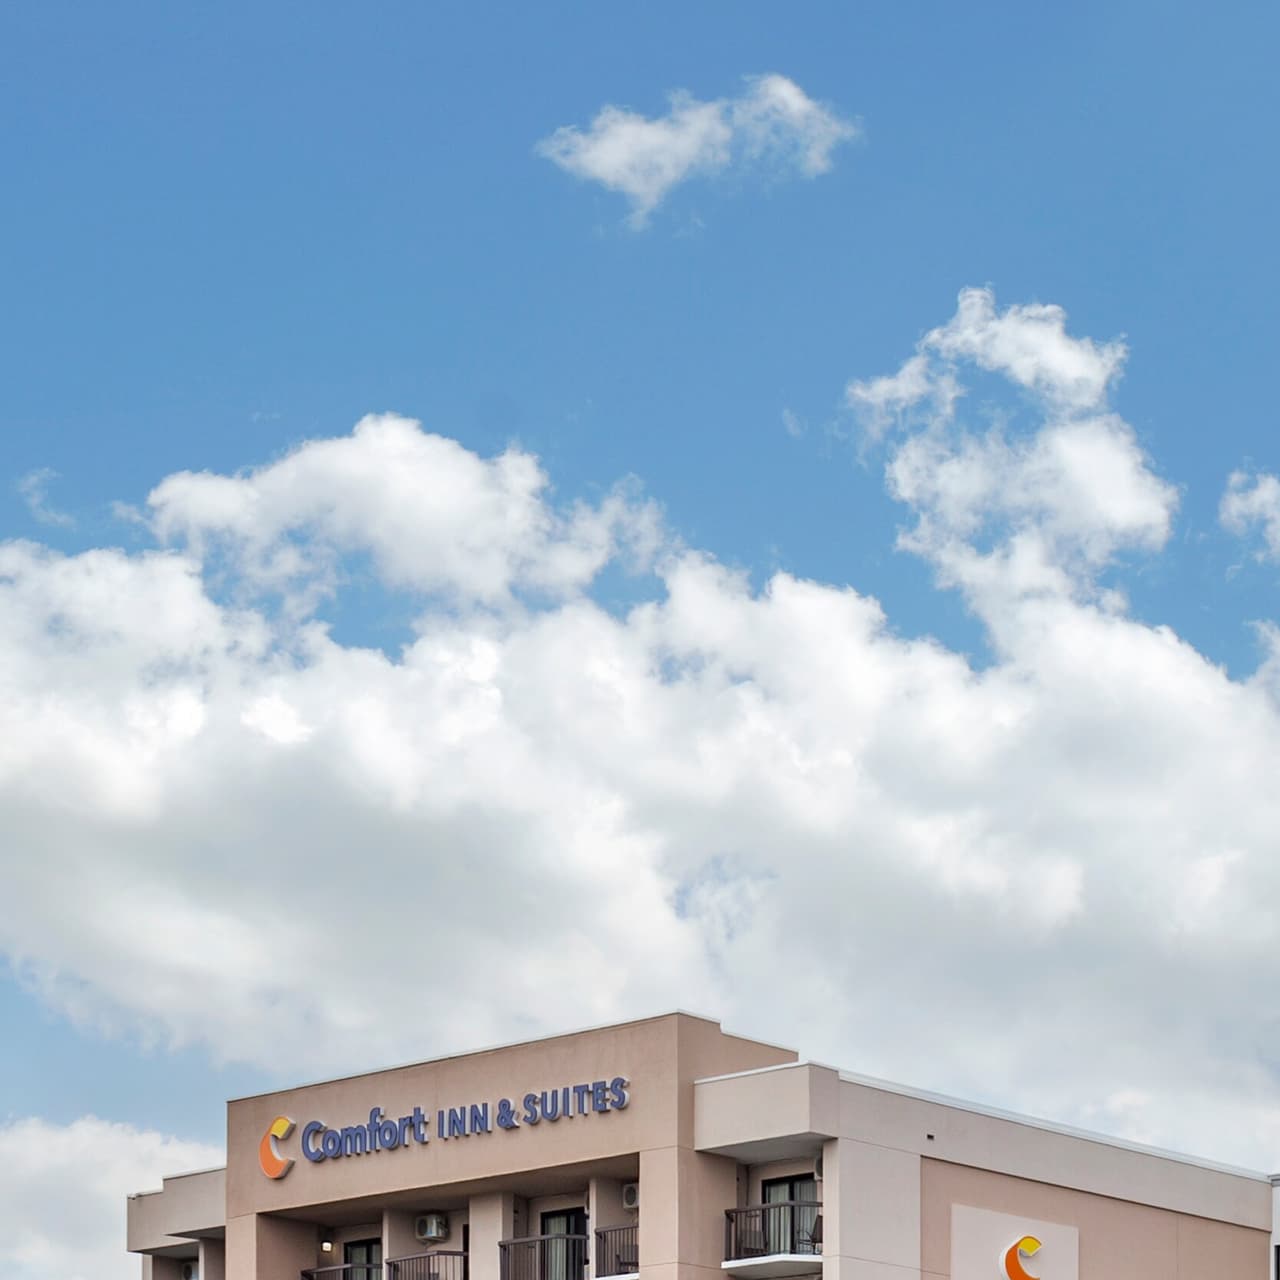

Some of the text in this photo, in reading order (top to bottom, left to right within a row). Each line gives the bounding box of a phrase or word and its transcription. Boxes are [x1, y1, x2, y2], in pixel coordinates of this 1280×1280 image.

[302, 1076, 630, 1163] Comfort INN & SUITES
